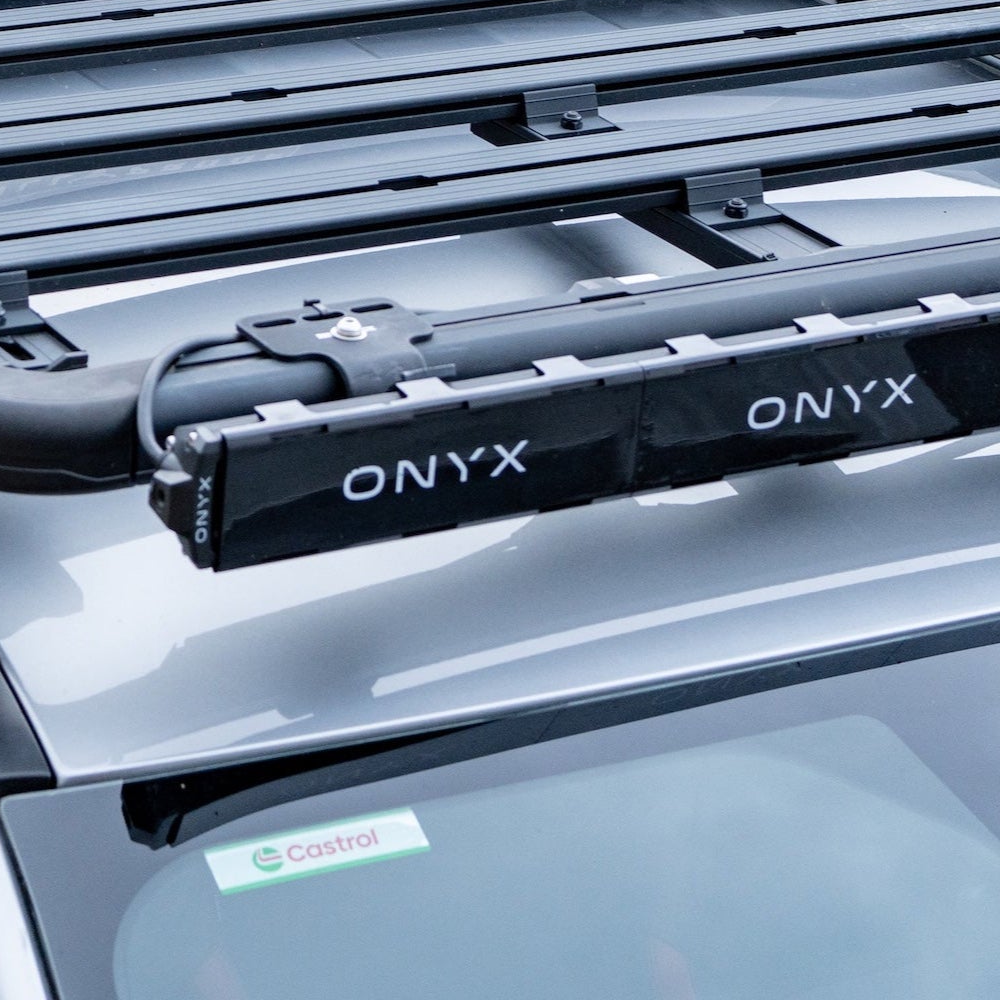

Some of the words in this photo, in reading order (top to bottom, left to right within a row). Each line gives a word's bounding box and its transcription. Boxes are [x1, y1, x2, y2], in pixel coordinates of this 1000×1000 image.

[747, 373, 917, 431] ONYX
[342, 439, 529, 501] ONYX
[194, 475, 213, 544] ONYX
[287, 829, 380, 863] Castrol
